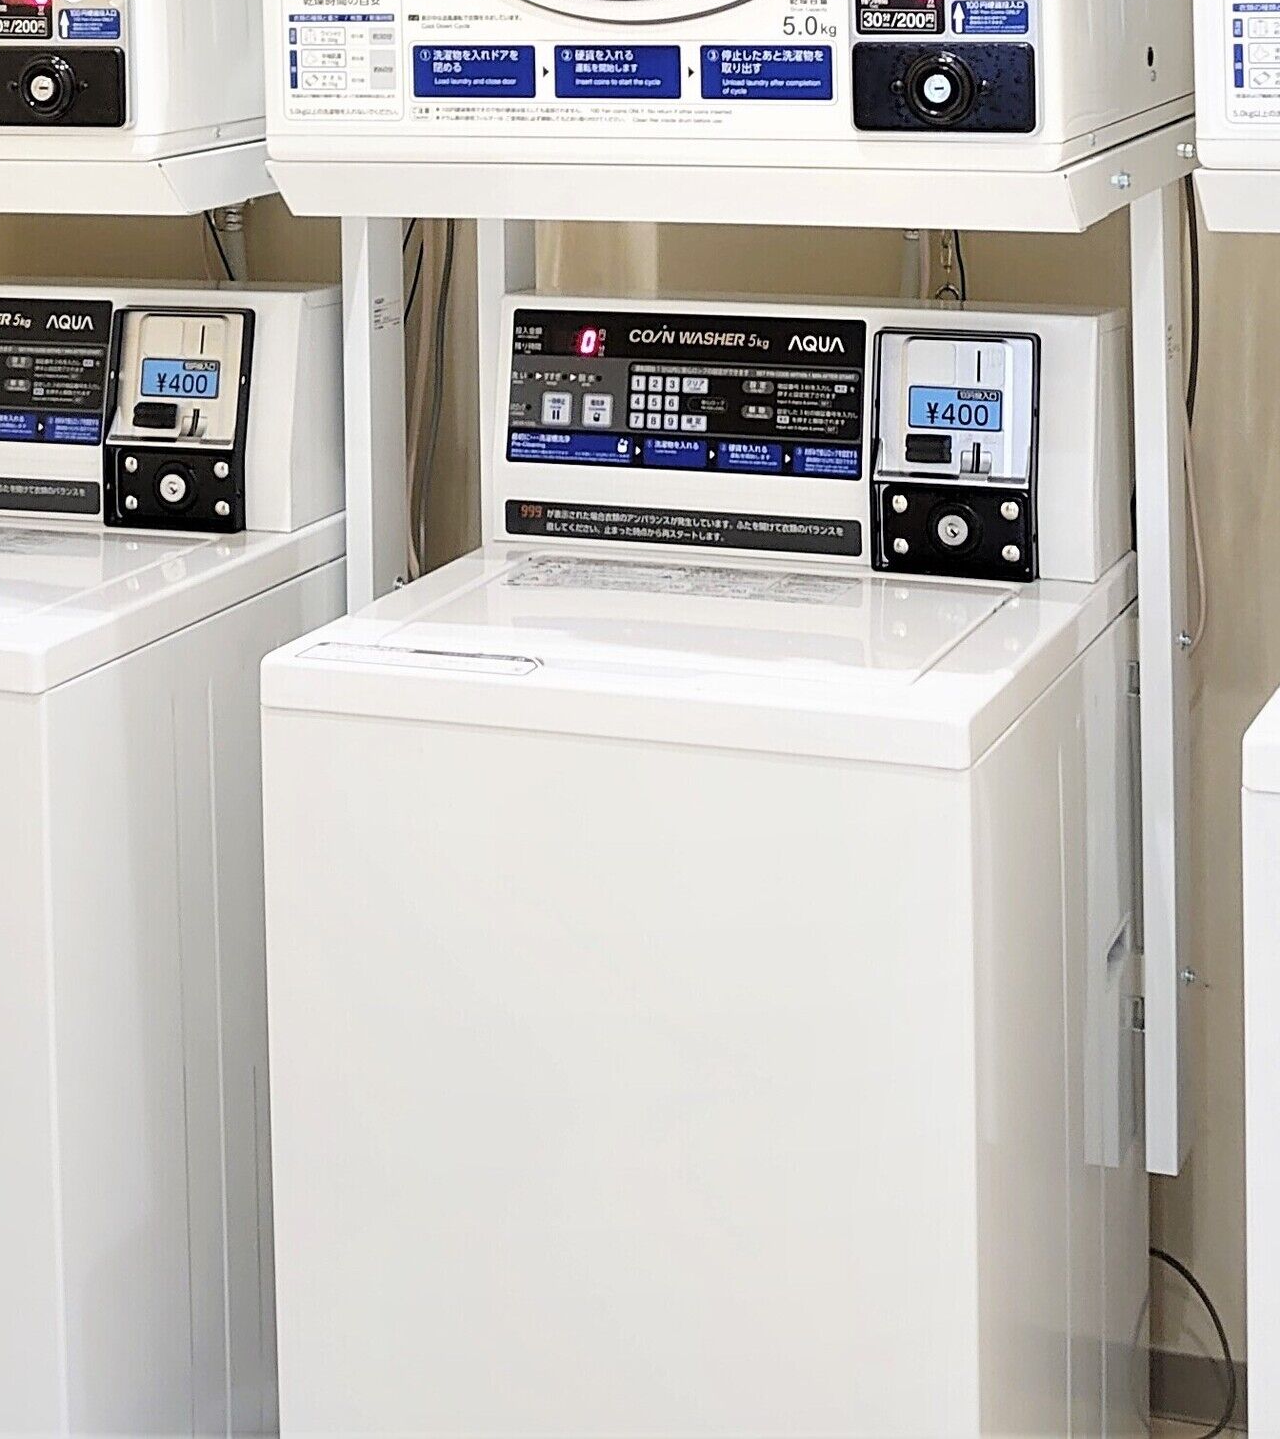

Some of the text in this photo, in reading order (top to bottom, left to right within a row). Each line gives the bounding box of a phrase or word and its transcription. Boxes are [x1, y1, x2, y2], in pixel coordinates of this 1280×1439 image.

[782, 15, 837, 37] 5.0 kg
[46, 315, 93, 330] AQUA
[580, 330, 597, 354] 0
[629, 325, 675, 344] COIN
[679, 331, 744, 346] WASHER
[788, 335, 845, 353] AQUA
[157, 373, 208, 394] ¥400
[926, 402, 988, 426] ¥400
